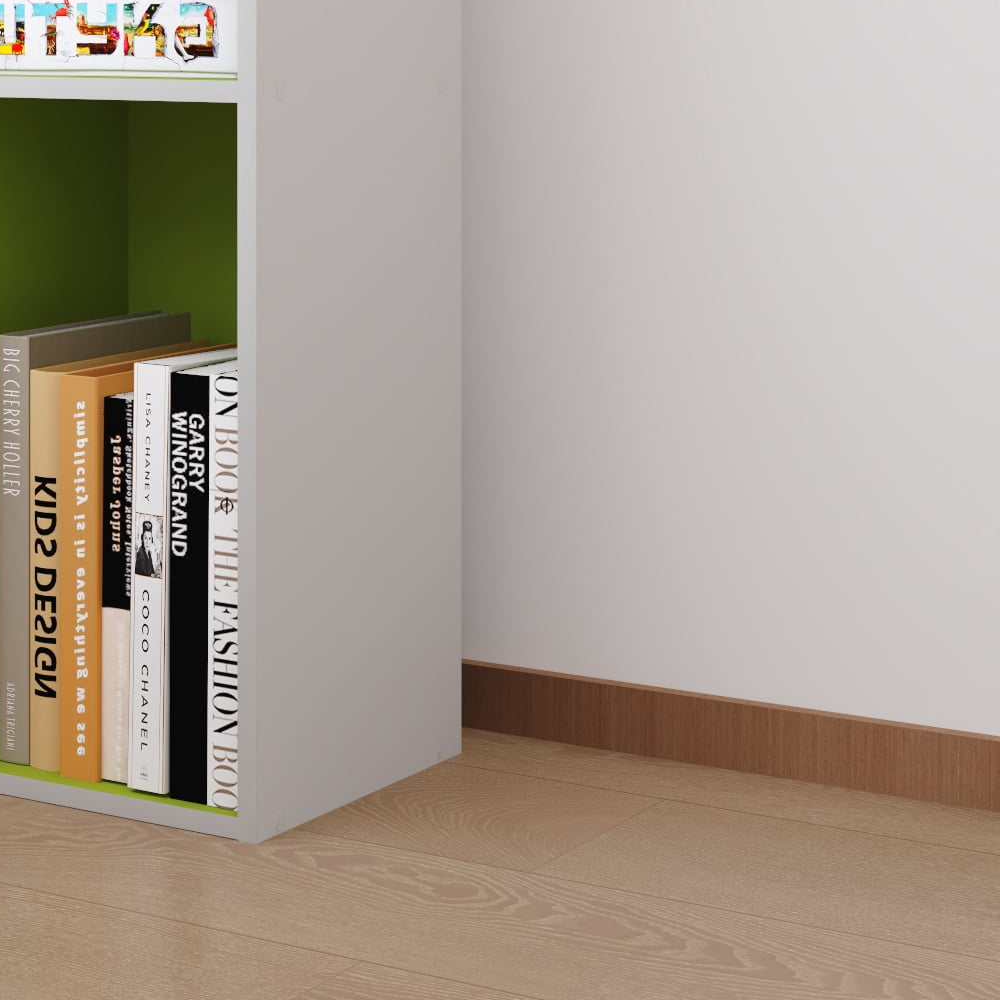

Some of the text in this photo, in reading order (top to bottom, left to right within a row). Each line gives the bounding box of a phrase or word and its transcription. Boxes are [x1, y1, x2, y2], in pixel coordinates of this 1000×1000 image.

[3, 347, 21, 496] BIG CHERRY HOLLER
[142, 392, 152, 503] LISA CHANEY
[188, 413, 206, 493] GARRY
[214, 374, 238, 417] ON
[171, 411, 189, 558] WINOGRAND
[212, 527, 238, 593] THE
[139, 589, 151, 751] COCO CHANEL
[211, 599, 238, 737] FASHION
